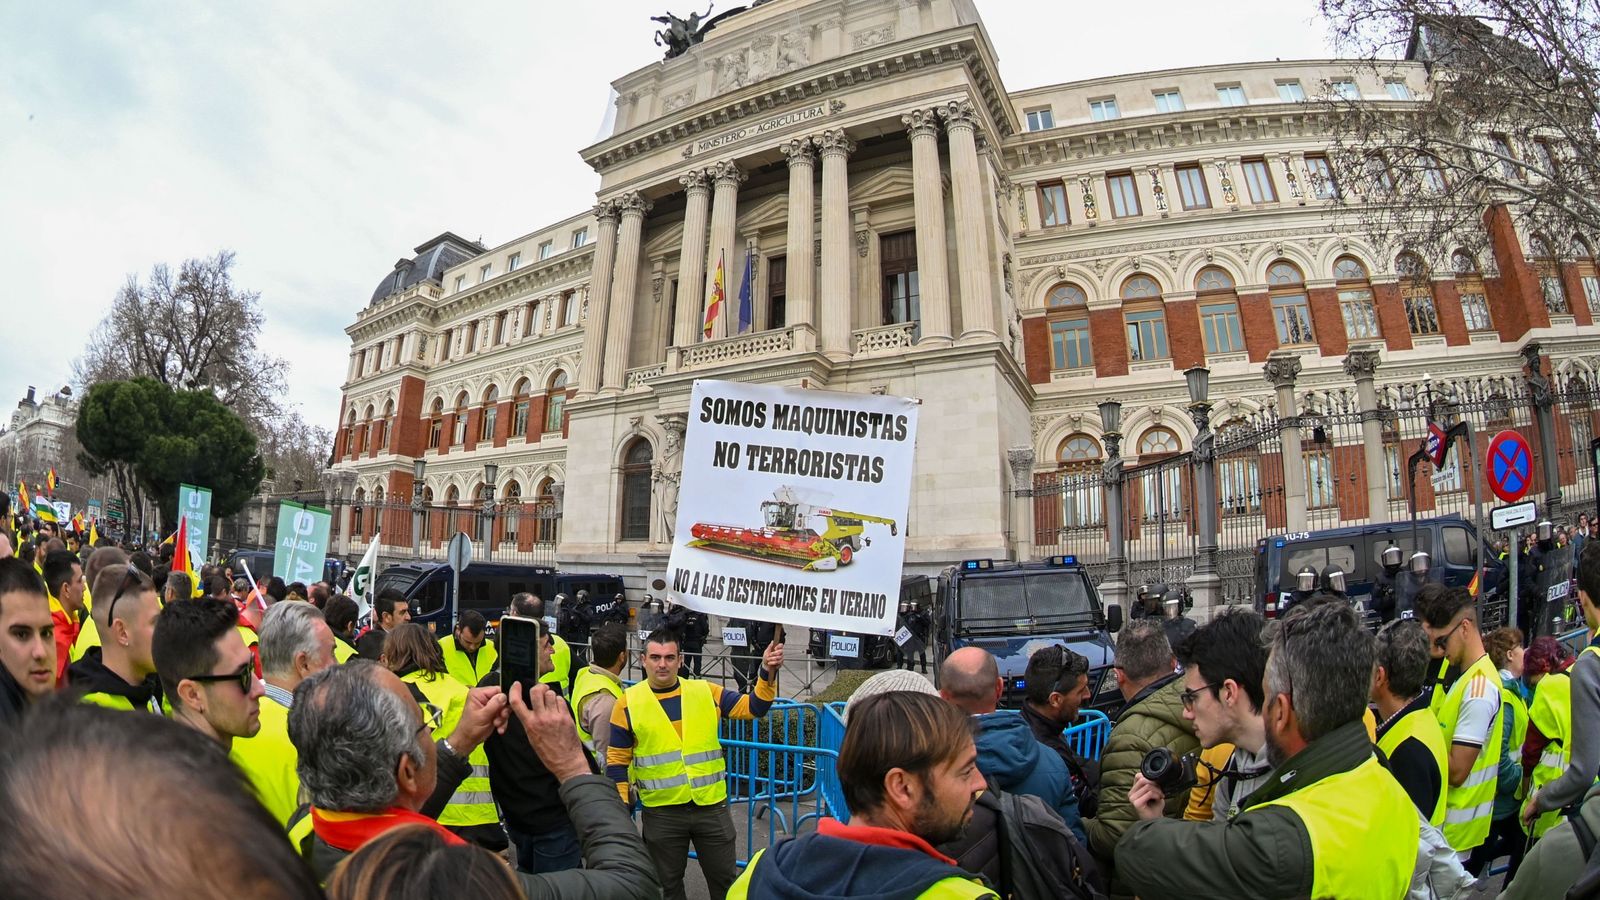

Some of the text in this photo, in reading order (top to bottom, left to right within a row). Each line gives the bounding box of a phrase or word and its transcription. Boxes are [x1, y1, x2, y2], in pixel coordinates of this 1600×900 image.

[698, 130, 746, 152] MINISTERIO
[756, 107, 824, 134] AGRICULTURA
[700, 396, 908, 442] SOMOS MAQUINISTAS
[713, 440, 885, 484] NO TERRORISTAS
[1284, 532, 1310, 541] 1U-75
[673, 568, 887, 620] NO A LAS RESTRICCIONES EN VERANO
[831, 641, 858, 653] POLICIA
